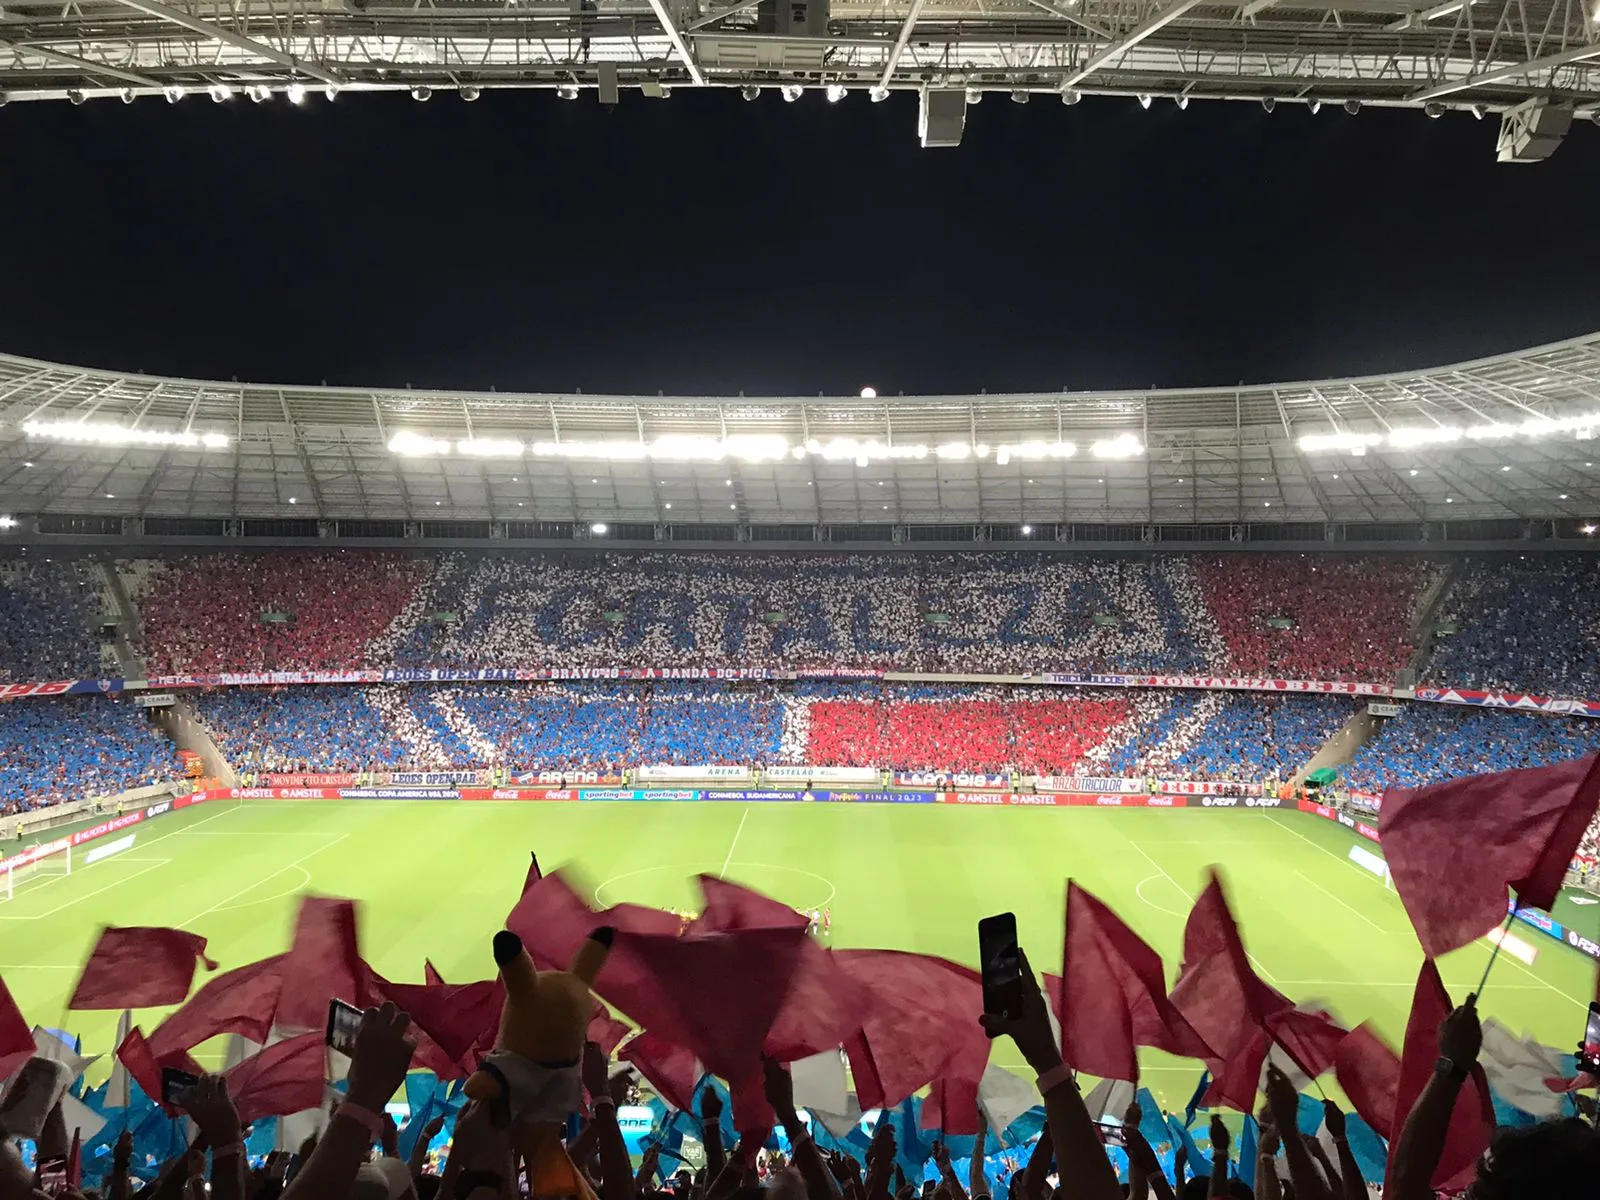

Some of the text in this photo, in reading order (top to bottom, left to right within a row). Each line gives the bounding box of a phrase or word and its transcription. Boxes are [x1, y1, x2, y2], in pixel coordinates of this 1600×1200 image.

[551, 668, 600, 679] BRAVO
[662, 668, 709, 679] BANDA
[716, 668, 733, 679] DO
[455, 773, 477, 784] BAR
[538, 771, 598, 784] ARENA
[240, 788, 275, 798] AMSTEL
[289, 788, 324, 798] AMSTEL
[644, 790, 692, 800] sportingbet
[708, 792, 745, 800] CONMEBOL
[864, 793, 895, 801] FINAL
[964, 793, 1004, 804] AMSTEL
[1019, 794, 1057, 805] AMSTEL
